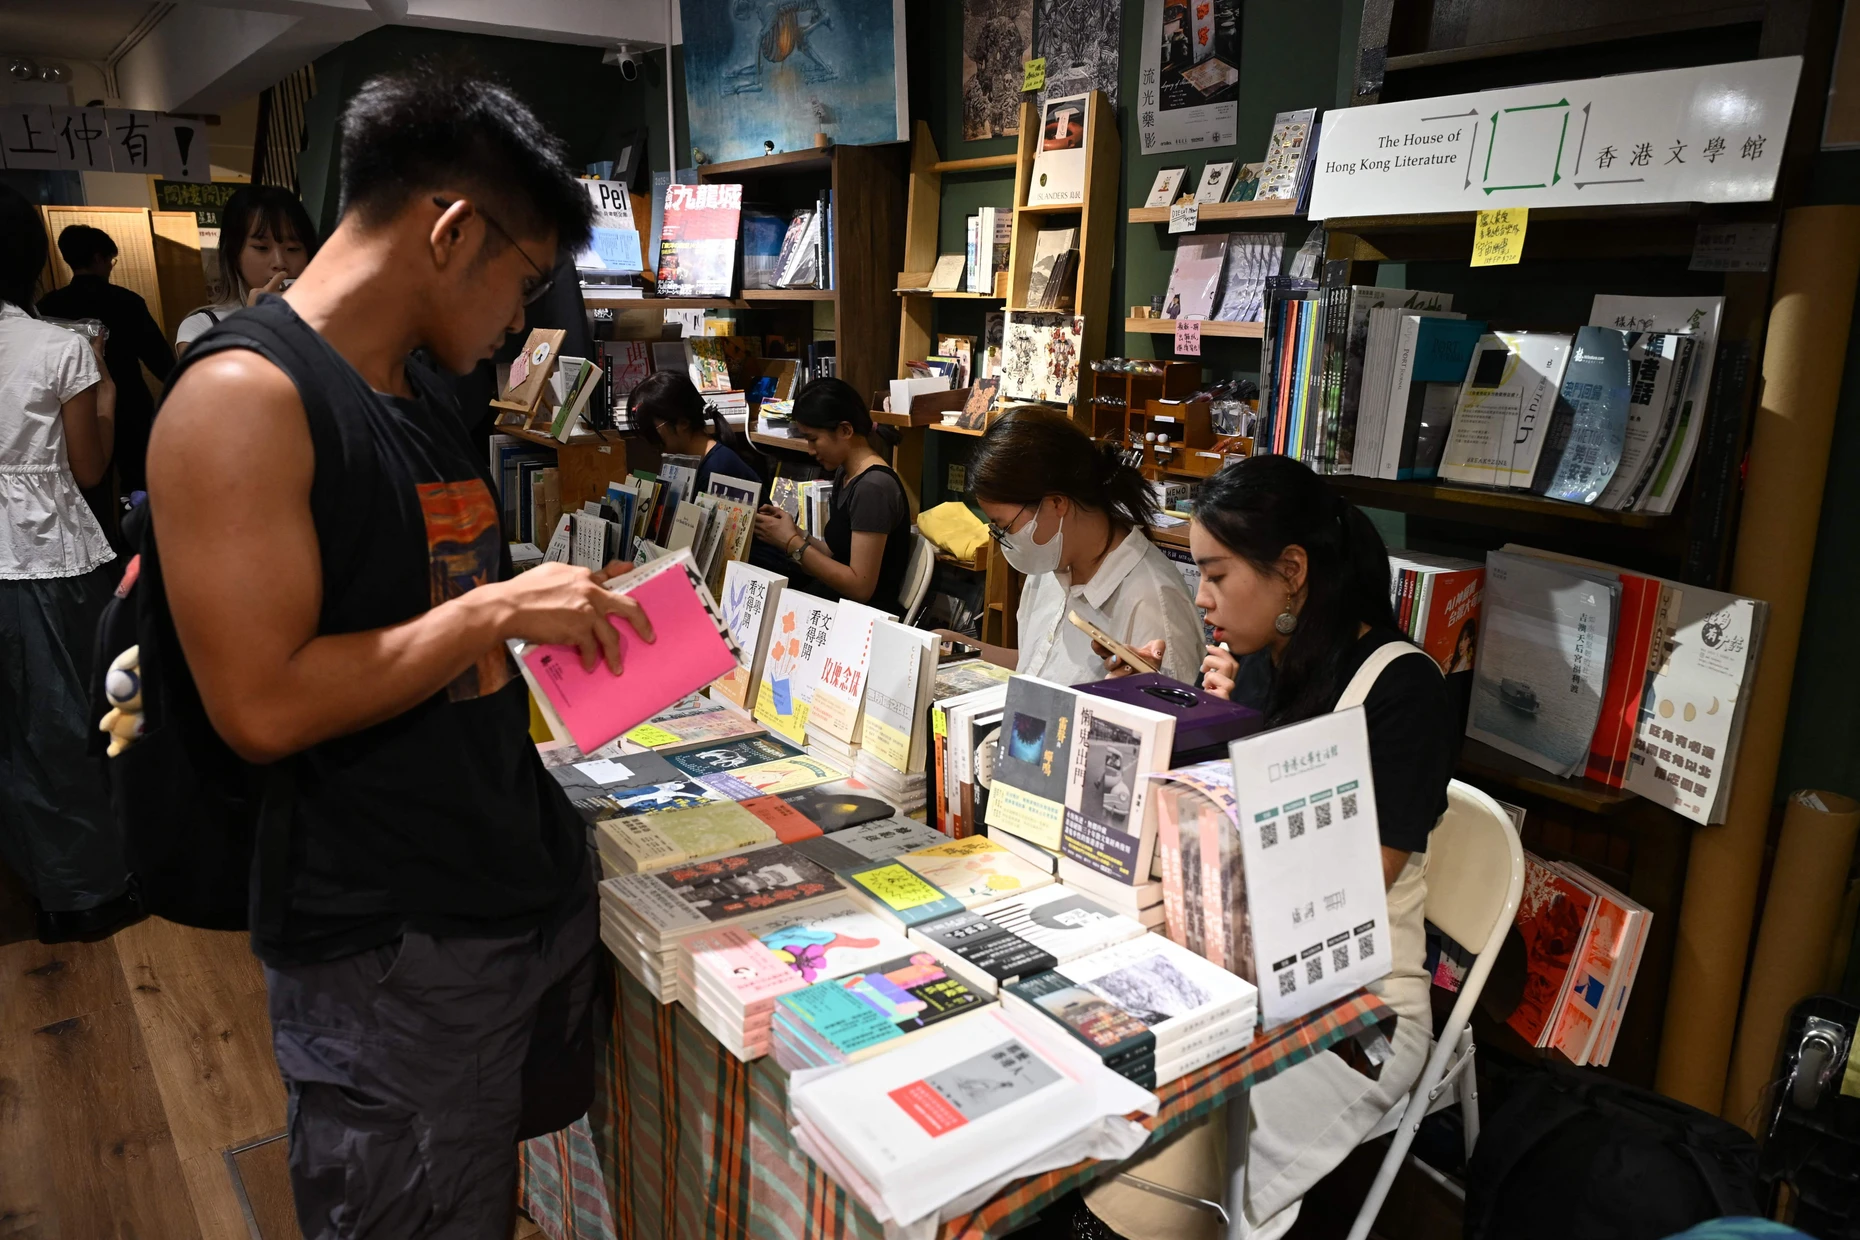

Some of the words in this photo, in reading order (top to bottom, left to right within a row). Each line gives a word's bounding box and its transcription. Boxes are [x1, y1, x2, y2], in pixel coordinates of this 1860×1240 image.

[1142, 68, 1156, 149] 流光藥影
[1378, 135, 1400, 149] The
[1403, 133, 1443, 147] House
[1447, 128, 1463, 143] of
[1595, 134, 1768, 170] 香港文學館
[1325, 161, 1356, 175] Hong
[1359, 157, 1391, 172] Kong
[1394, 153, 1458, 169] Literature
[599, 183, 628, 211] Pei
[674, 184, 743, 211] 九龍城
[1513, 393, 1543, 445] Truth
[1166, 486, 1187, 497] MEMO
[752, 583, 766, 616] 文學
[800, 609, 822, 662] 看得開
[815, 612, 833, 648] 文學
[820, 656, 862, 698] 玫瑰念珠
[1073, 706, 1094, 788] 懶鬼出門
